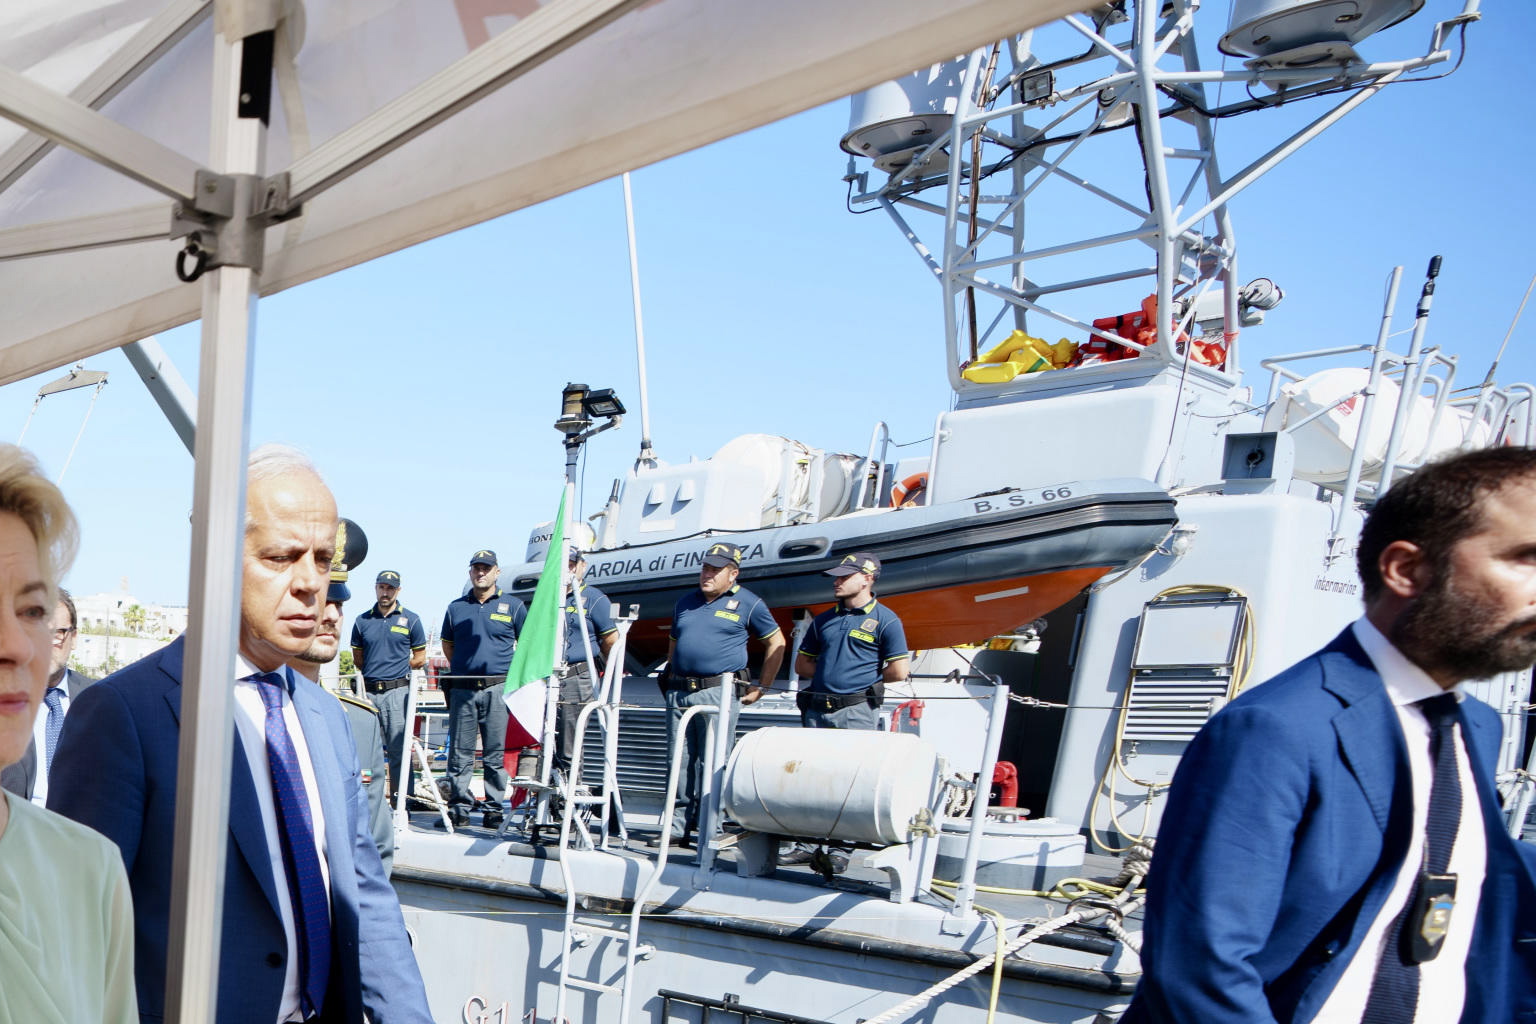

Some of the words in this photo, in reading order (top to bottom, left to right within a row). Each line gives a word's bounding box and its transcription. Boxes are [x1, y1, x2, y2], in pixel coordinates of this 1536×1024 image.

[974, 500, 1000, 514] B.
[1008, 495, 1034, 507] S.
[1041, 487, 1072, 502] 66
[584, 558, 643, 579] ARDIA
[649, 556, 667, 571] di
[672, 543, 764, 569] FINZA
